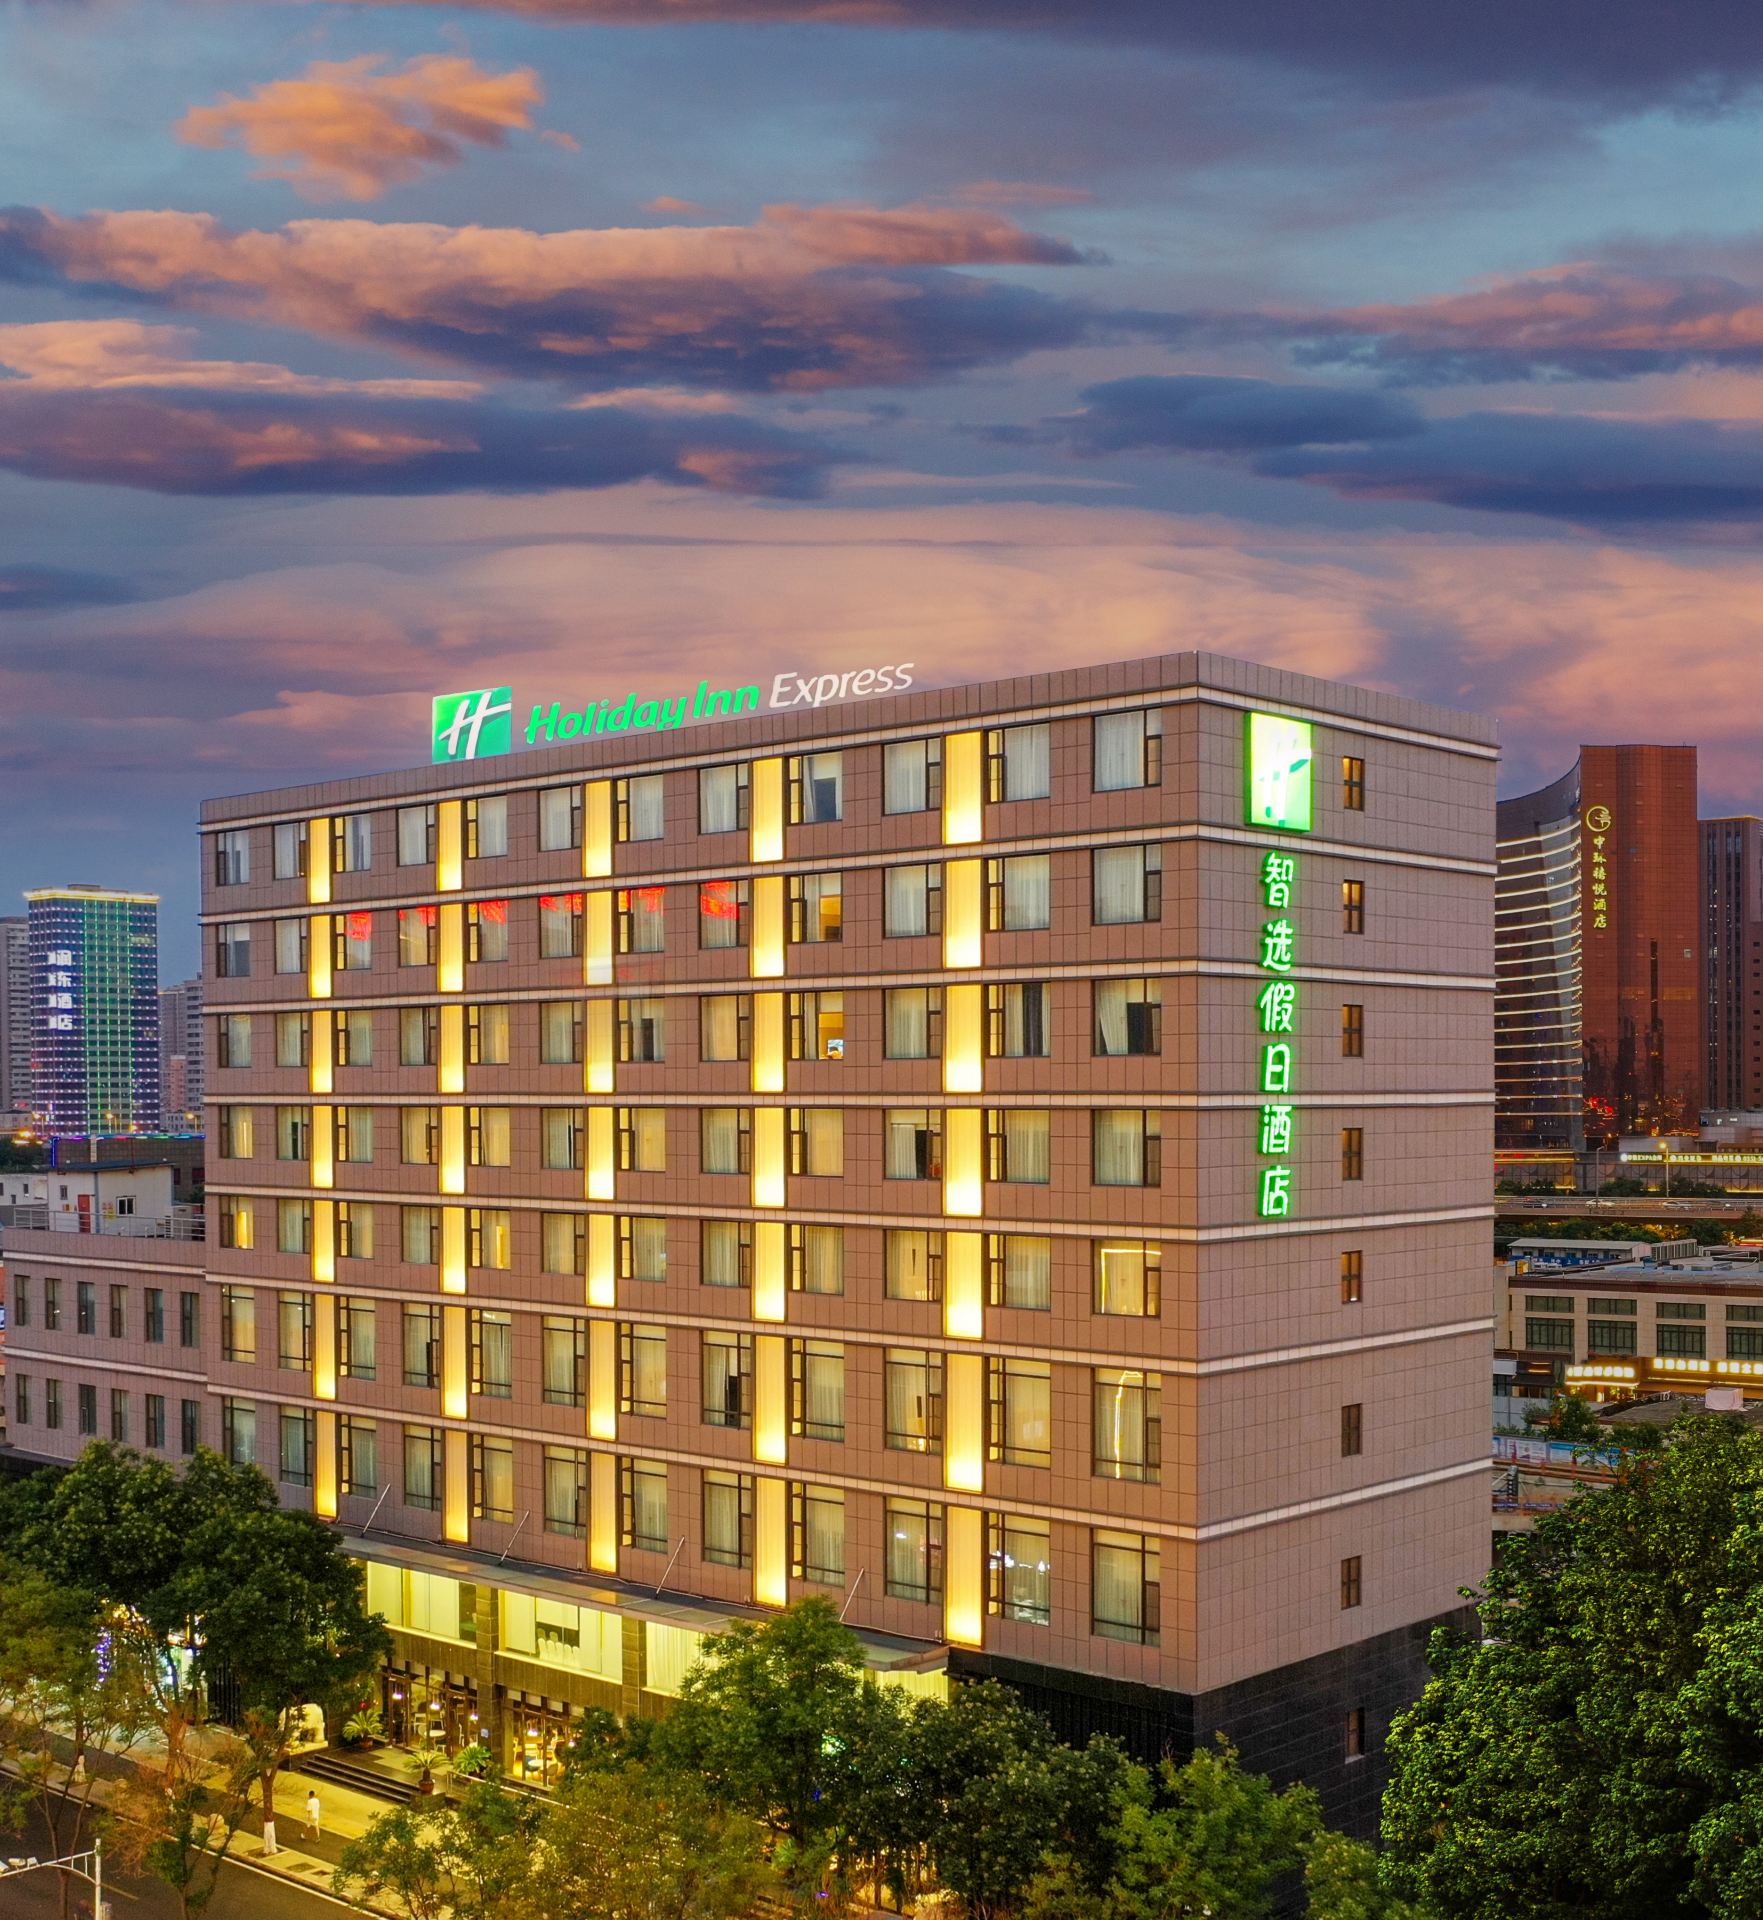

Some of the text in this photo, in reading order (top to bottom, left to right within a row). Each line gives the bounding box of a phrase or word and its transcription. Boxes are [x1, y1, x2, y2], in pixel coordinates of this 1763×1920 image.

[524, 662, 914, 744] Holiday Inn Express
[1259, 850, 1295, 1218] 智选假日酒店
